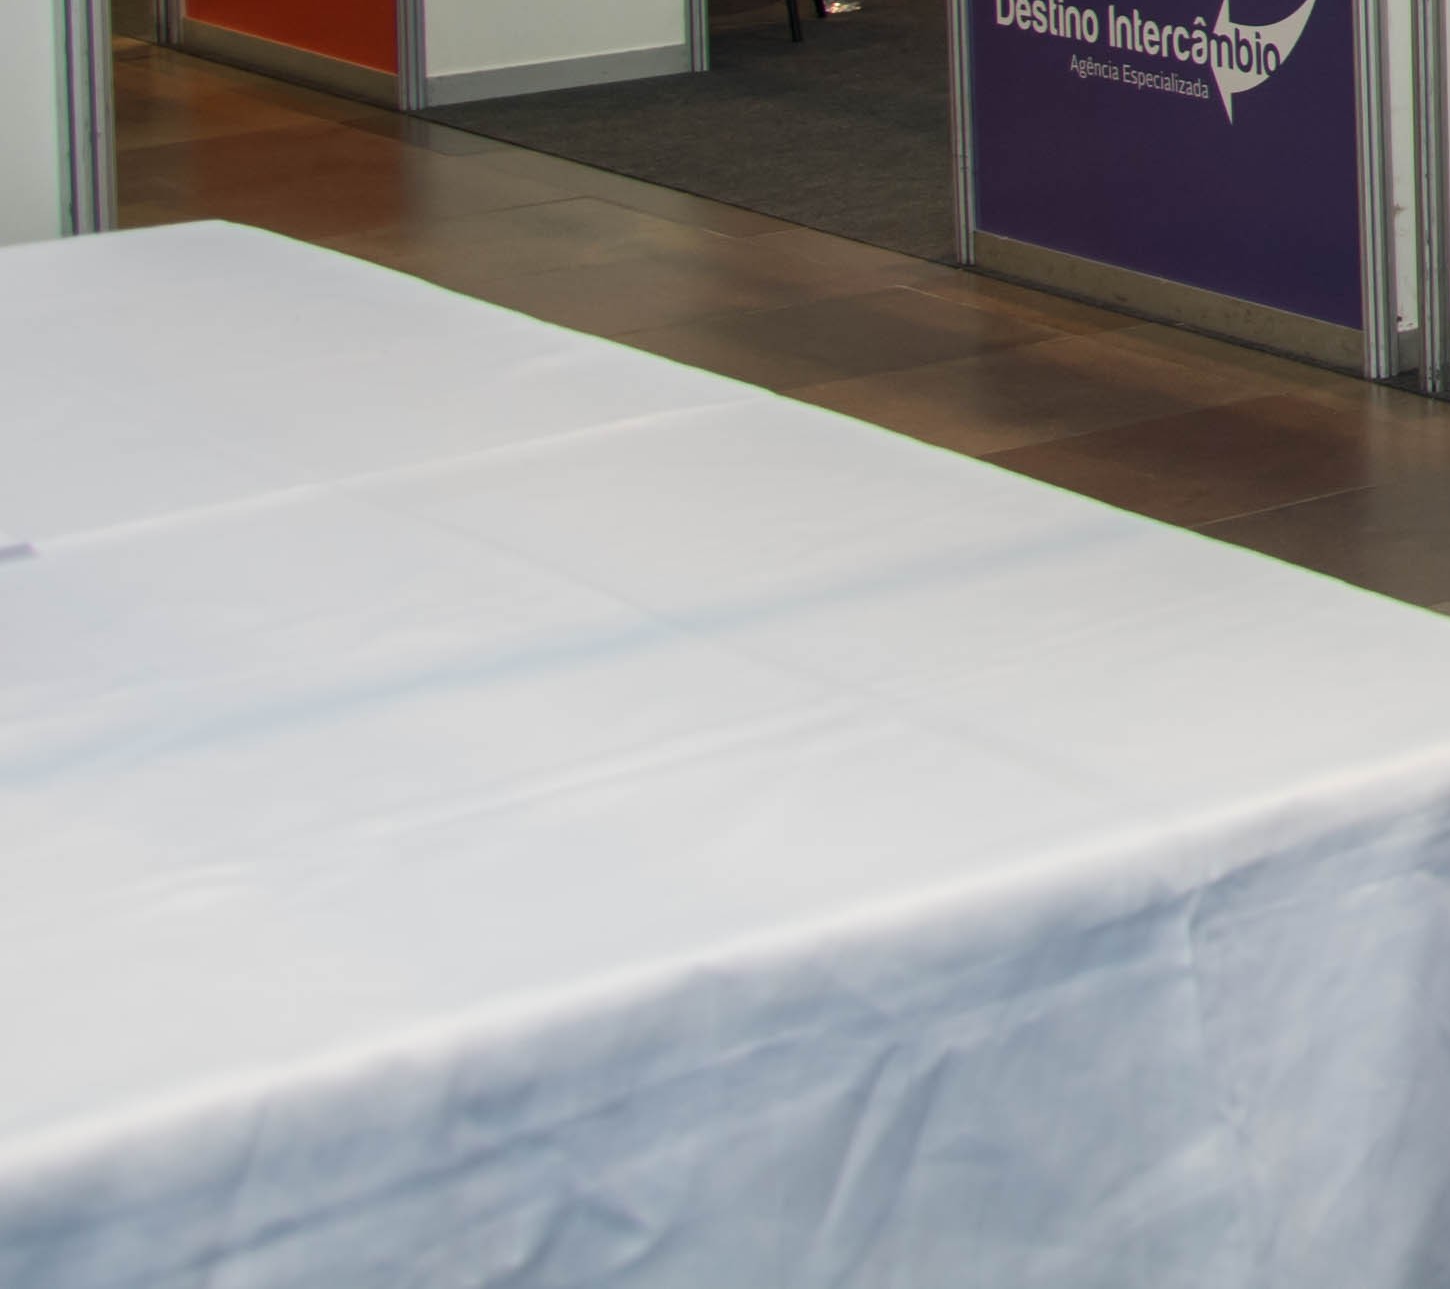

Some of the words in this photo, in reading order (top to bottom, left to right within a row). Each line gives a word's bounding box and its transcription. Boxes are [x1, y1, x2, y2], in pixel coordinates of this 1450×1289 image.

[1108, 5, 1281, 76] Intercâmbio
[1070, 54, 1119, 83] Agência
[1122, 64, 1209, 99] Especializada
